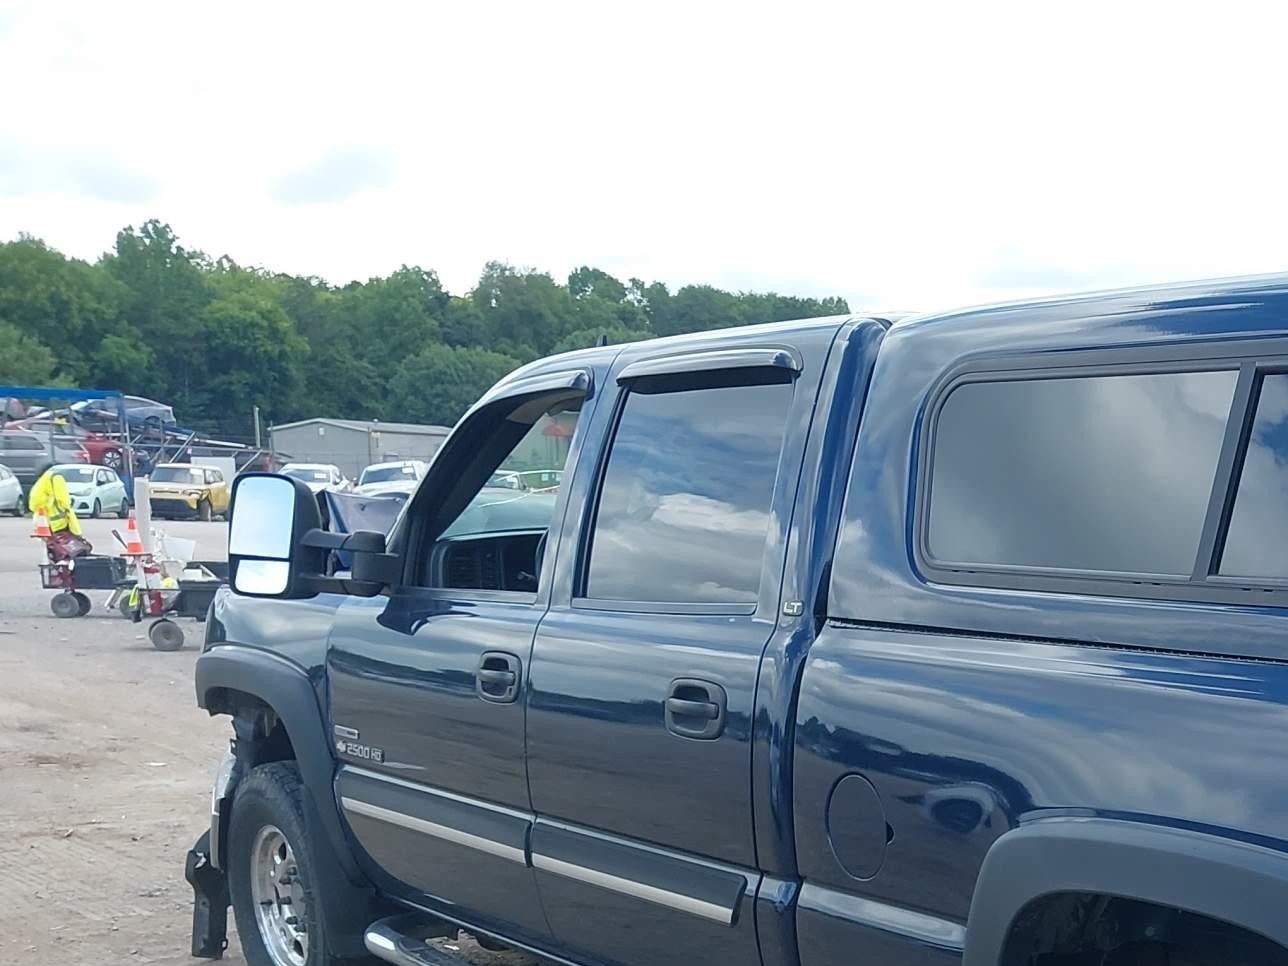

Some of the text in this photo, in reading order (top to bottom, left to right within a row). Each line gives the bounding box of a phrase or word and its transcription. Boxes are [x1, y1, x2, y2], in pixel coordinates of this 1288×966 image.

[783, 601, 803, 614] LT
[347, 742, 382, 761] 2500 HD
